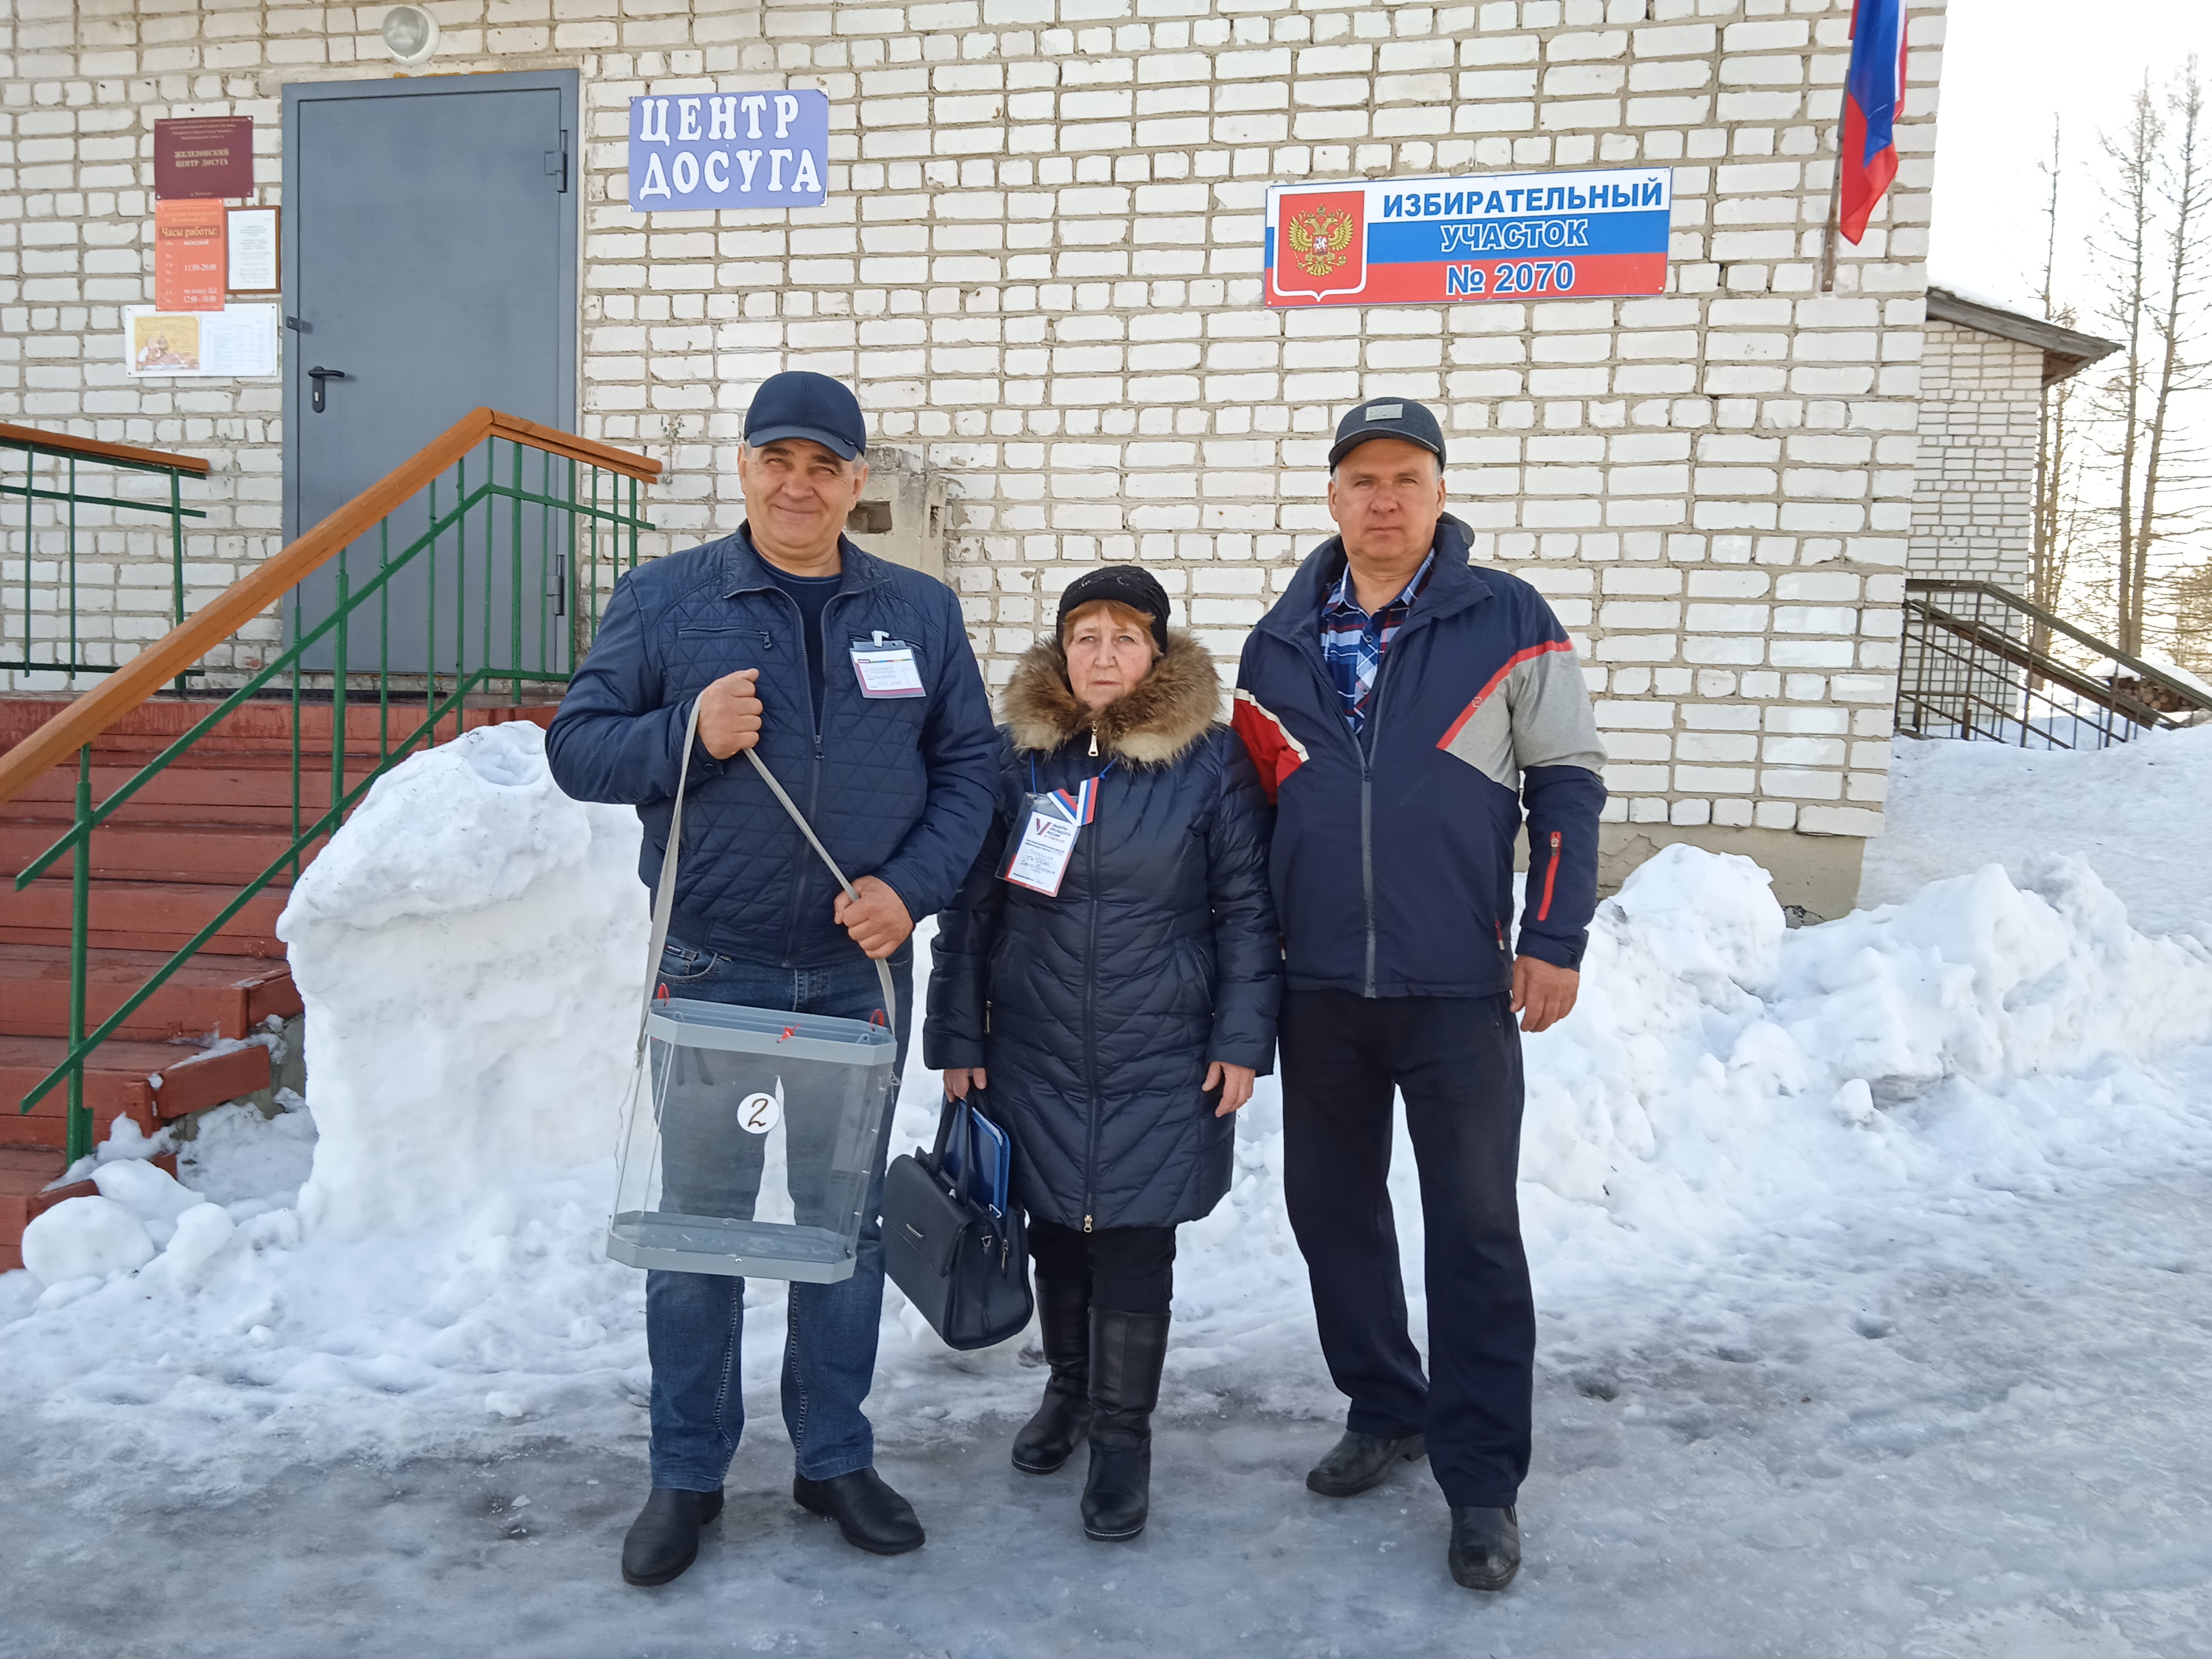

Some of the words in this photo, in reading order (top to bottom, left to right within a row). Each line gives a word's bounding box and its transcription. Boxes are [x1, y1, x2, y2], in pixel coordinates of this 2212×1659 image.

[639, 94, 799, 146] ЦЕНТР
[639, 148, 823, 200] ДОСУГА
[1383, 177, 1662, 218] ИЗБИРАТЕЛЬНЫЙ
[162, 227, 183, 237] Часы
[185, 226, 218, 239] работы:
[1440, 219, 1588, 252] УЧАСТОК
[1446, 265, 1486, 296] №
[1494, 260, 1576, 294] 2070
[747, 1097, 769, 1128] 2
